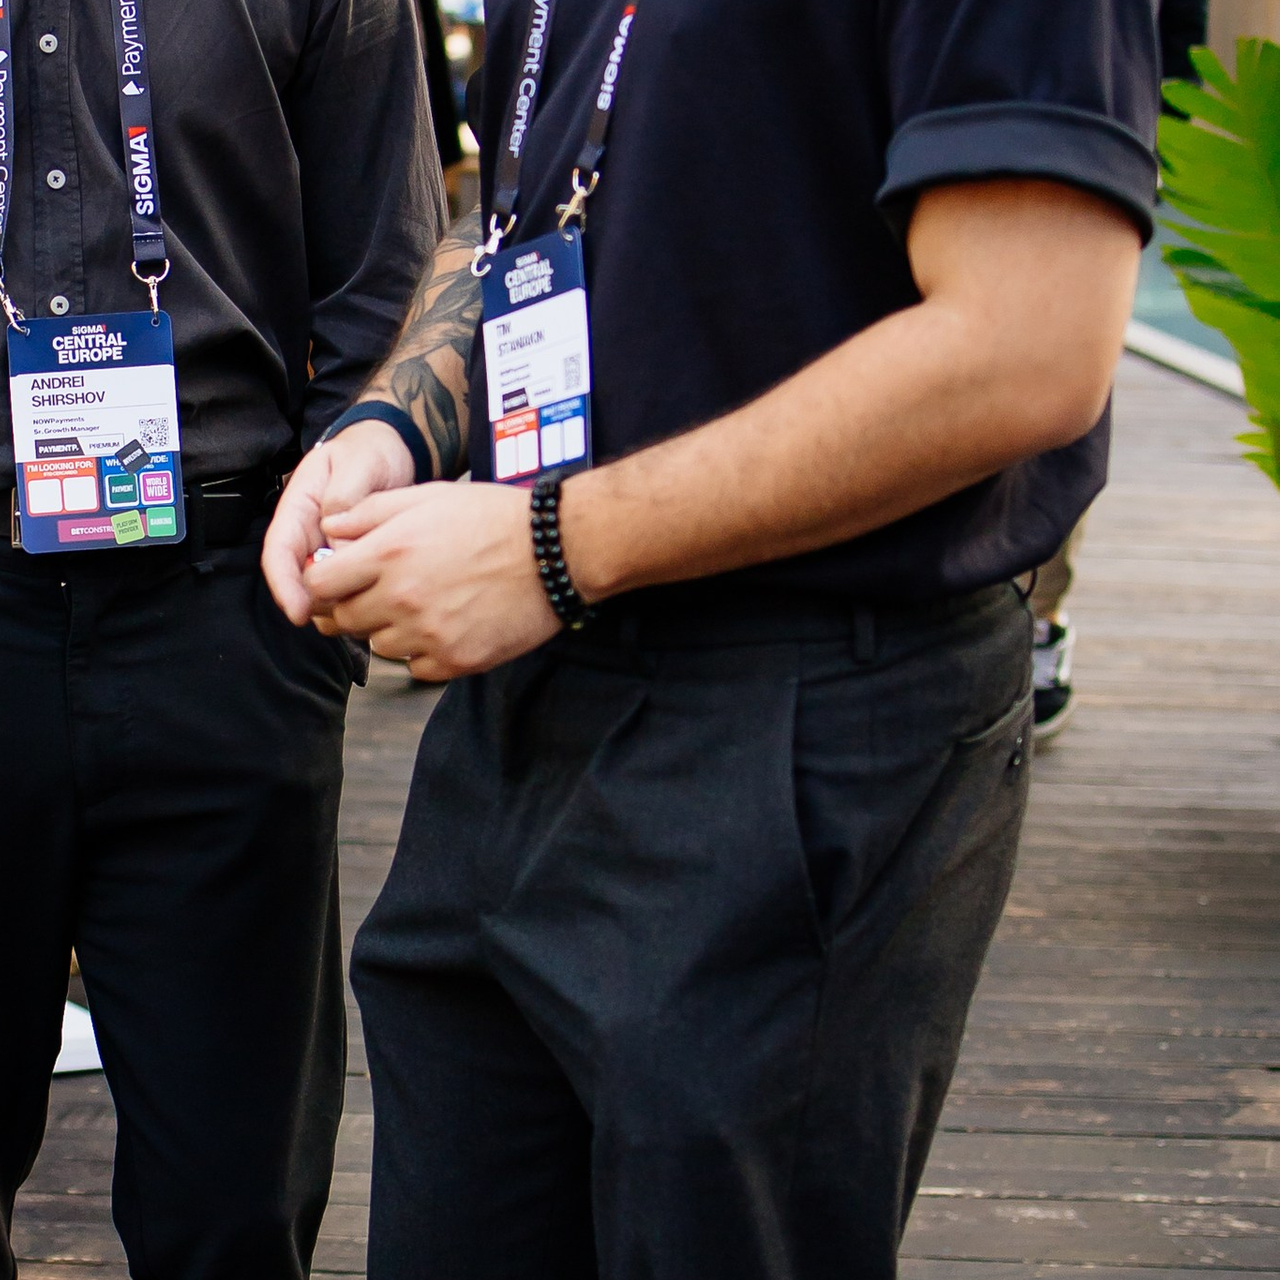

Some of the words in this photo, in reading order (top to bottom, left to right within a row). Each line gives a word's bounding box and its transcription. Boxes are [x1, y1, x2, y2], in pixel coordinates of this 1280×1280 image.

[507, 79, 537, 160] Center
[52, 332, 128, 351] CENTRAL
[58, 346, 124, 365] EUROPE
[30, 375, 85, 391] ANDREI
[31, 390, 106, 408] SHIRSHOV
[32, 416, 85, 426] NOWPayments
[44, 426, 70, 435] Growth
[70, 425, 100, 433] Manager
[89, 441, 121, 450] PREMIUM
[39, 462, 75, 472] LOOKING
[75, 460, 94, 469] FOR:
[146, 485, 169, 497] WIDE
